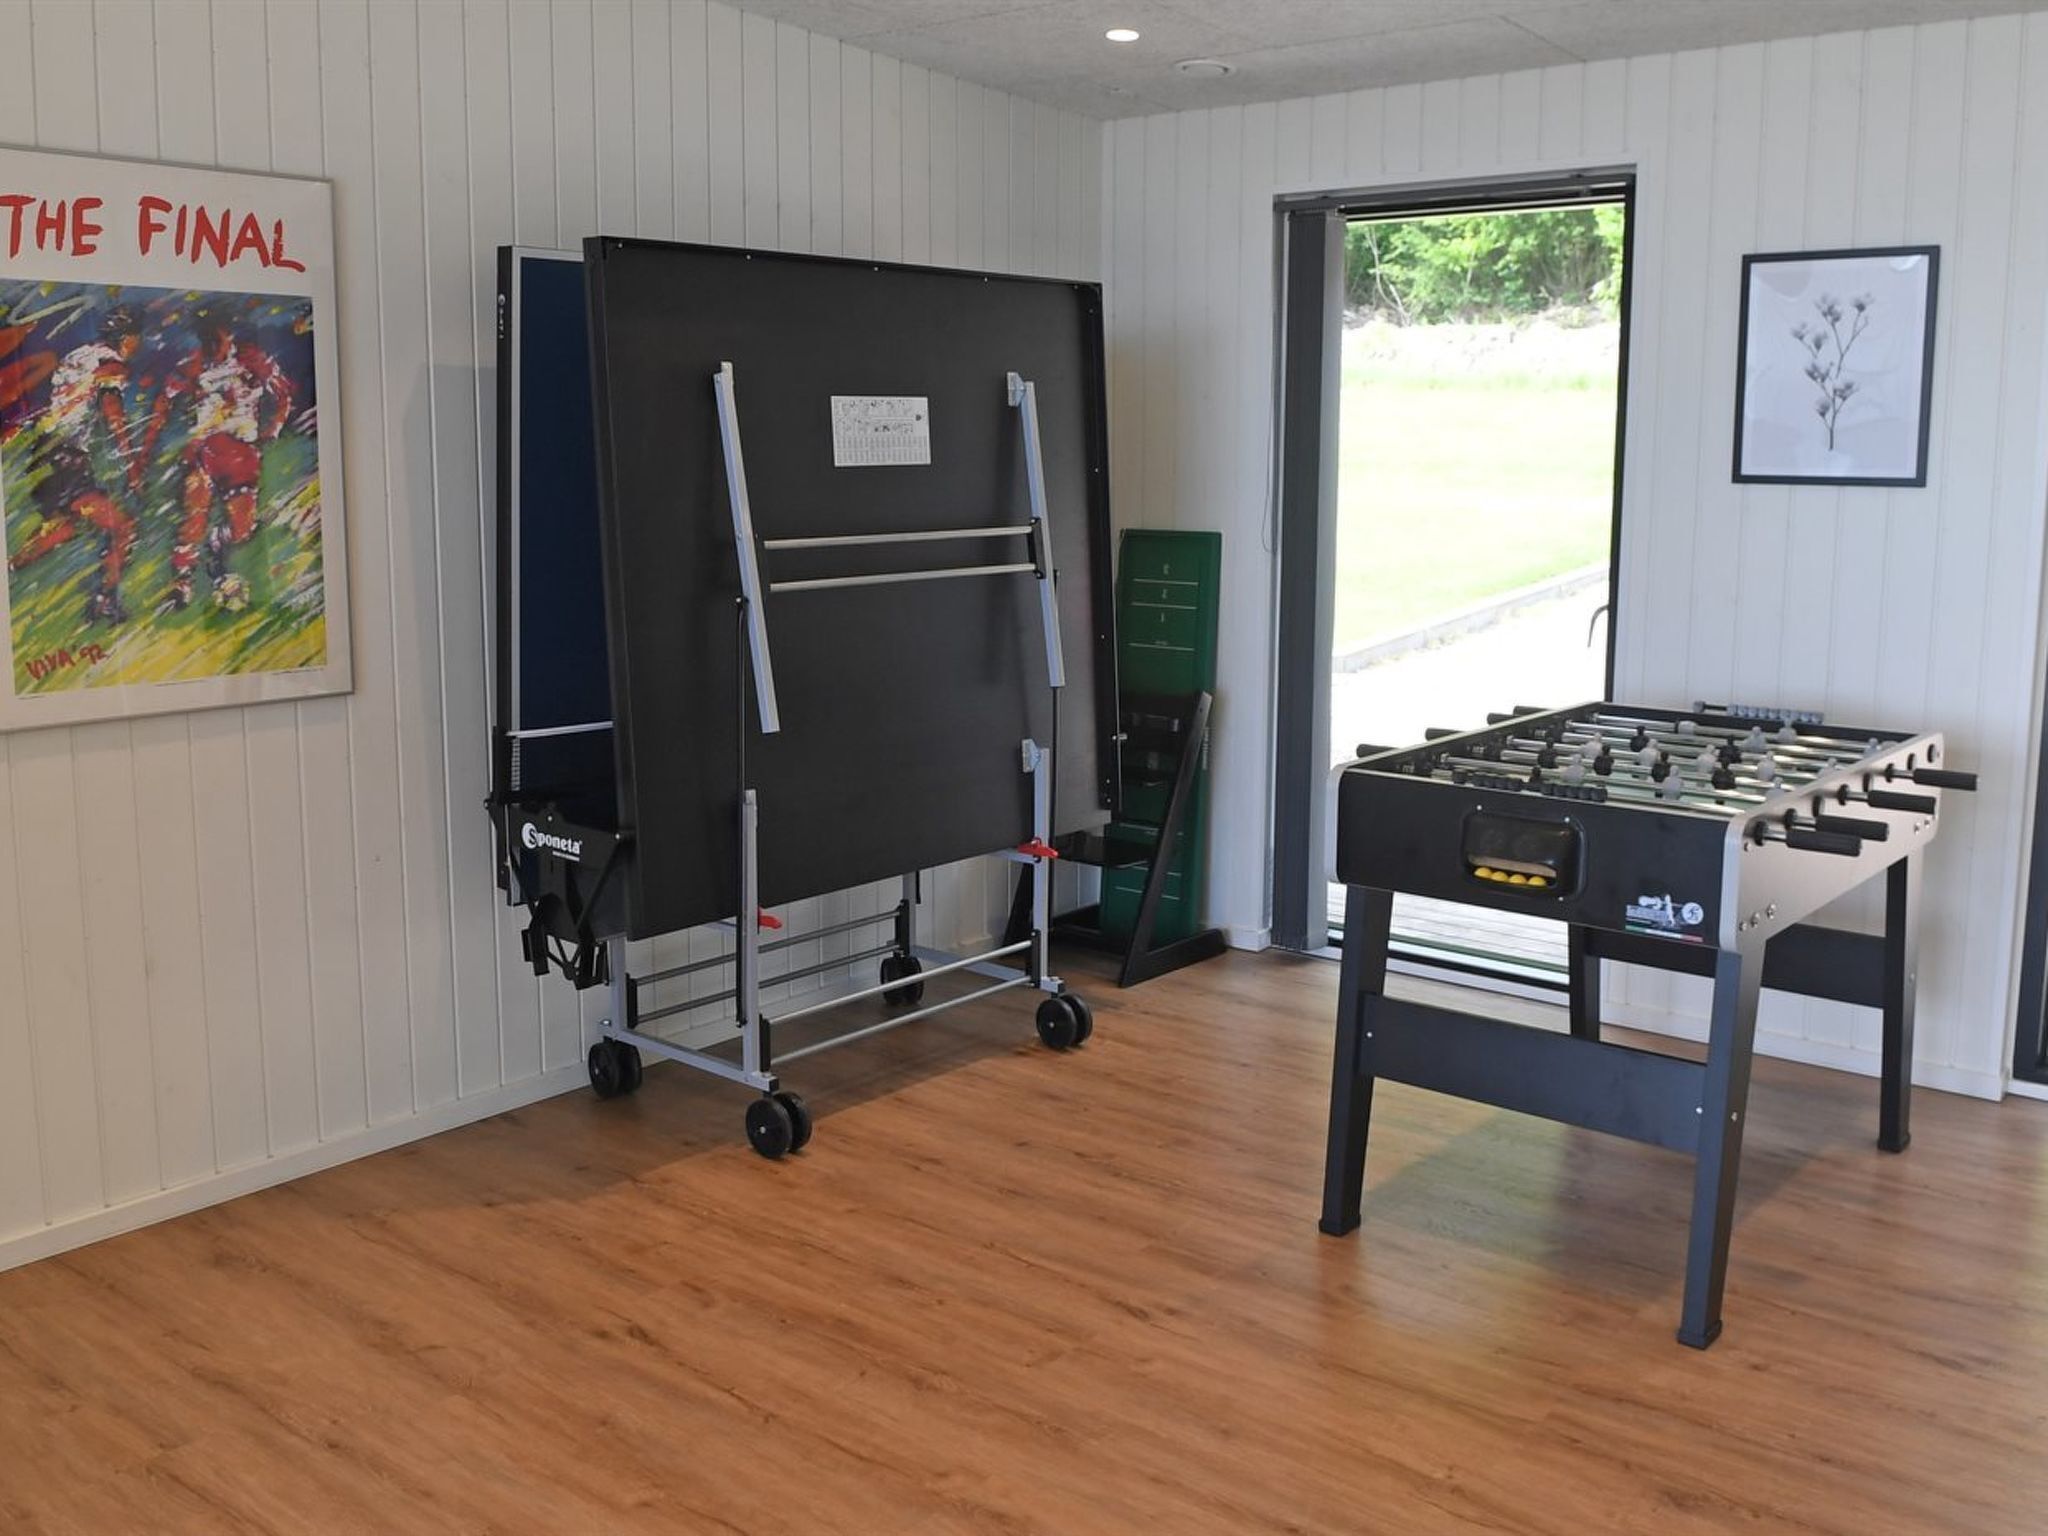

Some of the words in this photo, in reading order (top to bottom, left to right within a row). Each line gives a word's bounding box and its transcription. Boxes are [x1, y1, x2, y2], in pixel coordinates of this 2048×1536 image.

[0, 195, 104, 259] THE
[138, 196, 306, 273] FINAL
[521, 822, 581, 855] Sponeta
